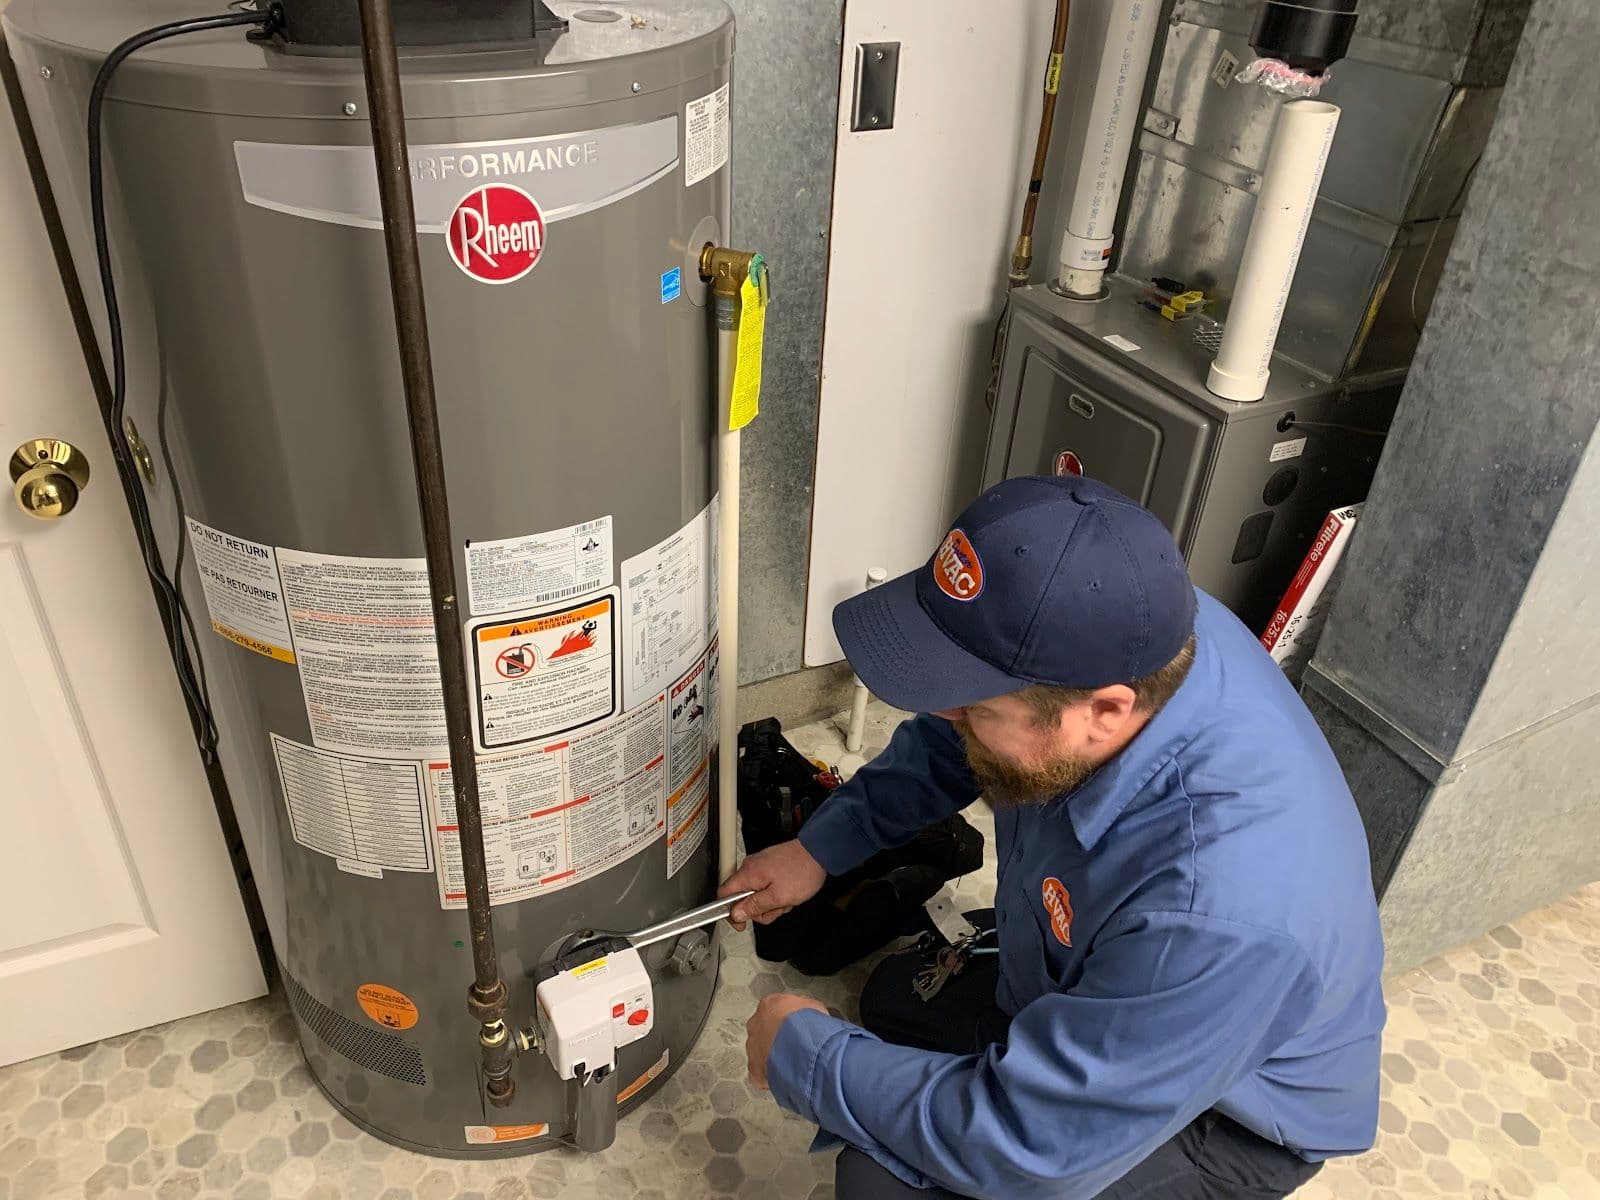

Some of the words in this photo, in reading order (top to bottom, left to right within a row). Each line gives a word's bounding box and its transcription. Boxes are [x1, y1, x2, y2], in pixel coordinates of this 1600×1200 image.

[411, 142, 599, 180] RFORMANCE
[458, 186, 540, 268] Rheem
[191, 522, 203, 535] DO
[204, 529, 223, 545] NOT
[225, 538, 269, 559] RETURN
[1310, 518, 1340, 561] Filtrete
[201, 565, 210, 577] NE
[211, 569, 226, 584] PAS
[226, 577, 279, 602] RETOURNER
[524, 615, 585, 634] AVERTISSEMENT
[538, 614, 573, 626] WARNING
[680, 662, 704, 689] DANGER
